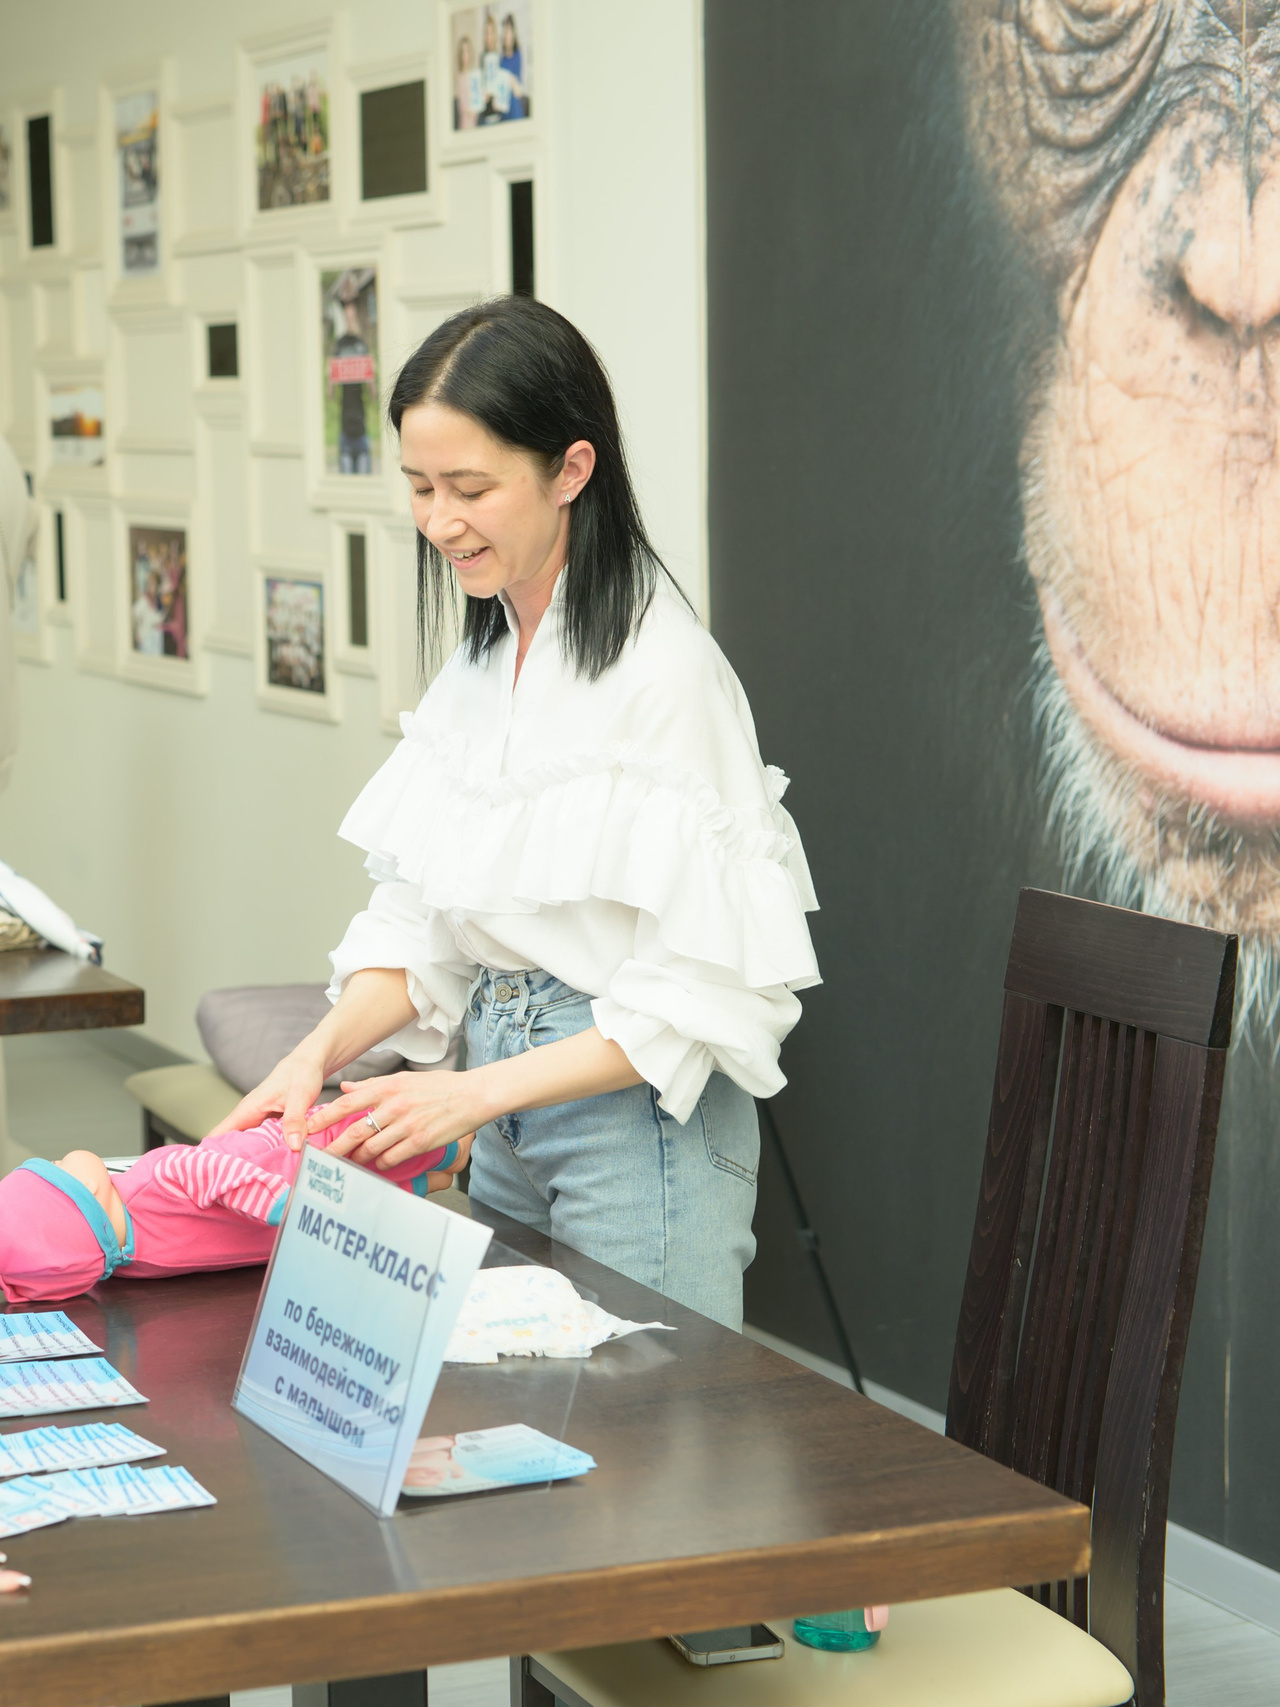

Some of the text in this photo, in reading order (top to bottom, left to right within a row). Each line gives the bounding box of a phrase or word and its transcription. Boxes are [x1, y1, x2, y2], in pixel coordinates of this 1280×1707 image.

[297, 1204, 446, 1300] МАСТЕР-КЛАСС
[265, 1327, 401, 1425] взаимодействию
[283, 1298, 401, 1386] по бережному
[274, 1375, 366, 1449] с малышом
